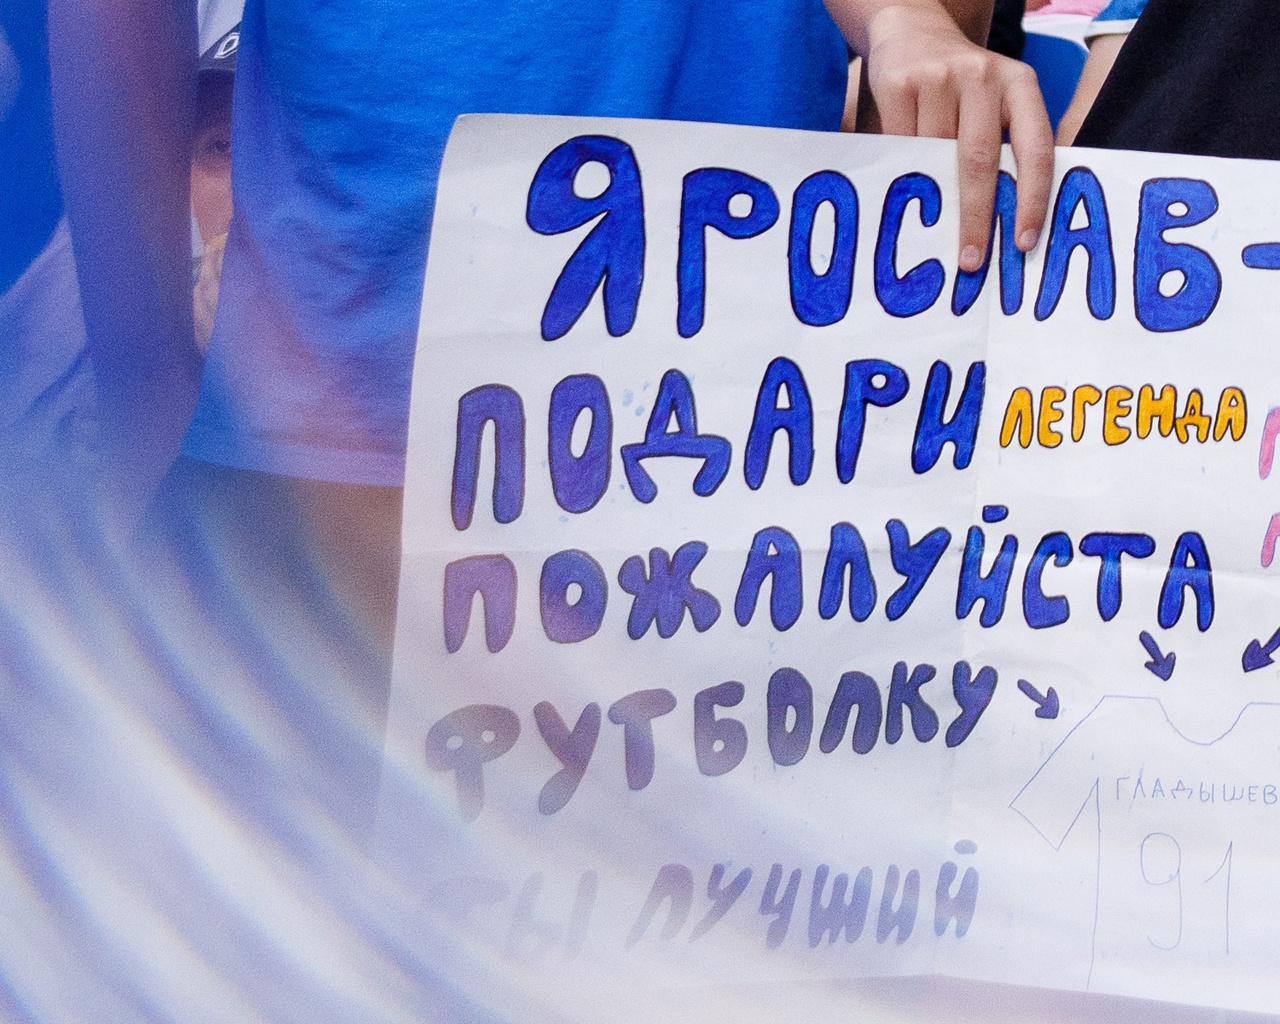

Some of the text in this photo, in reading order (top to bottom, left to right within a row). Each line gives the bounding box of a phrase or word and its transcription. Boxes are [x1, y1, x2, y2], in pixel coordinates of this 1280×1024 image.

[450, 356, 987, 531] ПОДАРИ
[999, 383, 1248, 449] ЛЕГЕНДА
[442, 504, 1216, 654] ПОЖАЛУЙСТА
[424, 659, 999, 824] ФУТБОЛКУ
[1115, 772, 1279, 807] ГЛАДЫШЕВ
[624, 838, 980, 950] ЛУЧШИЙ
[1139, 832, 1234, 956] 91
